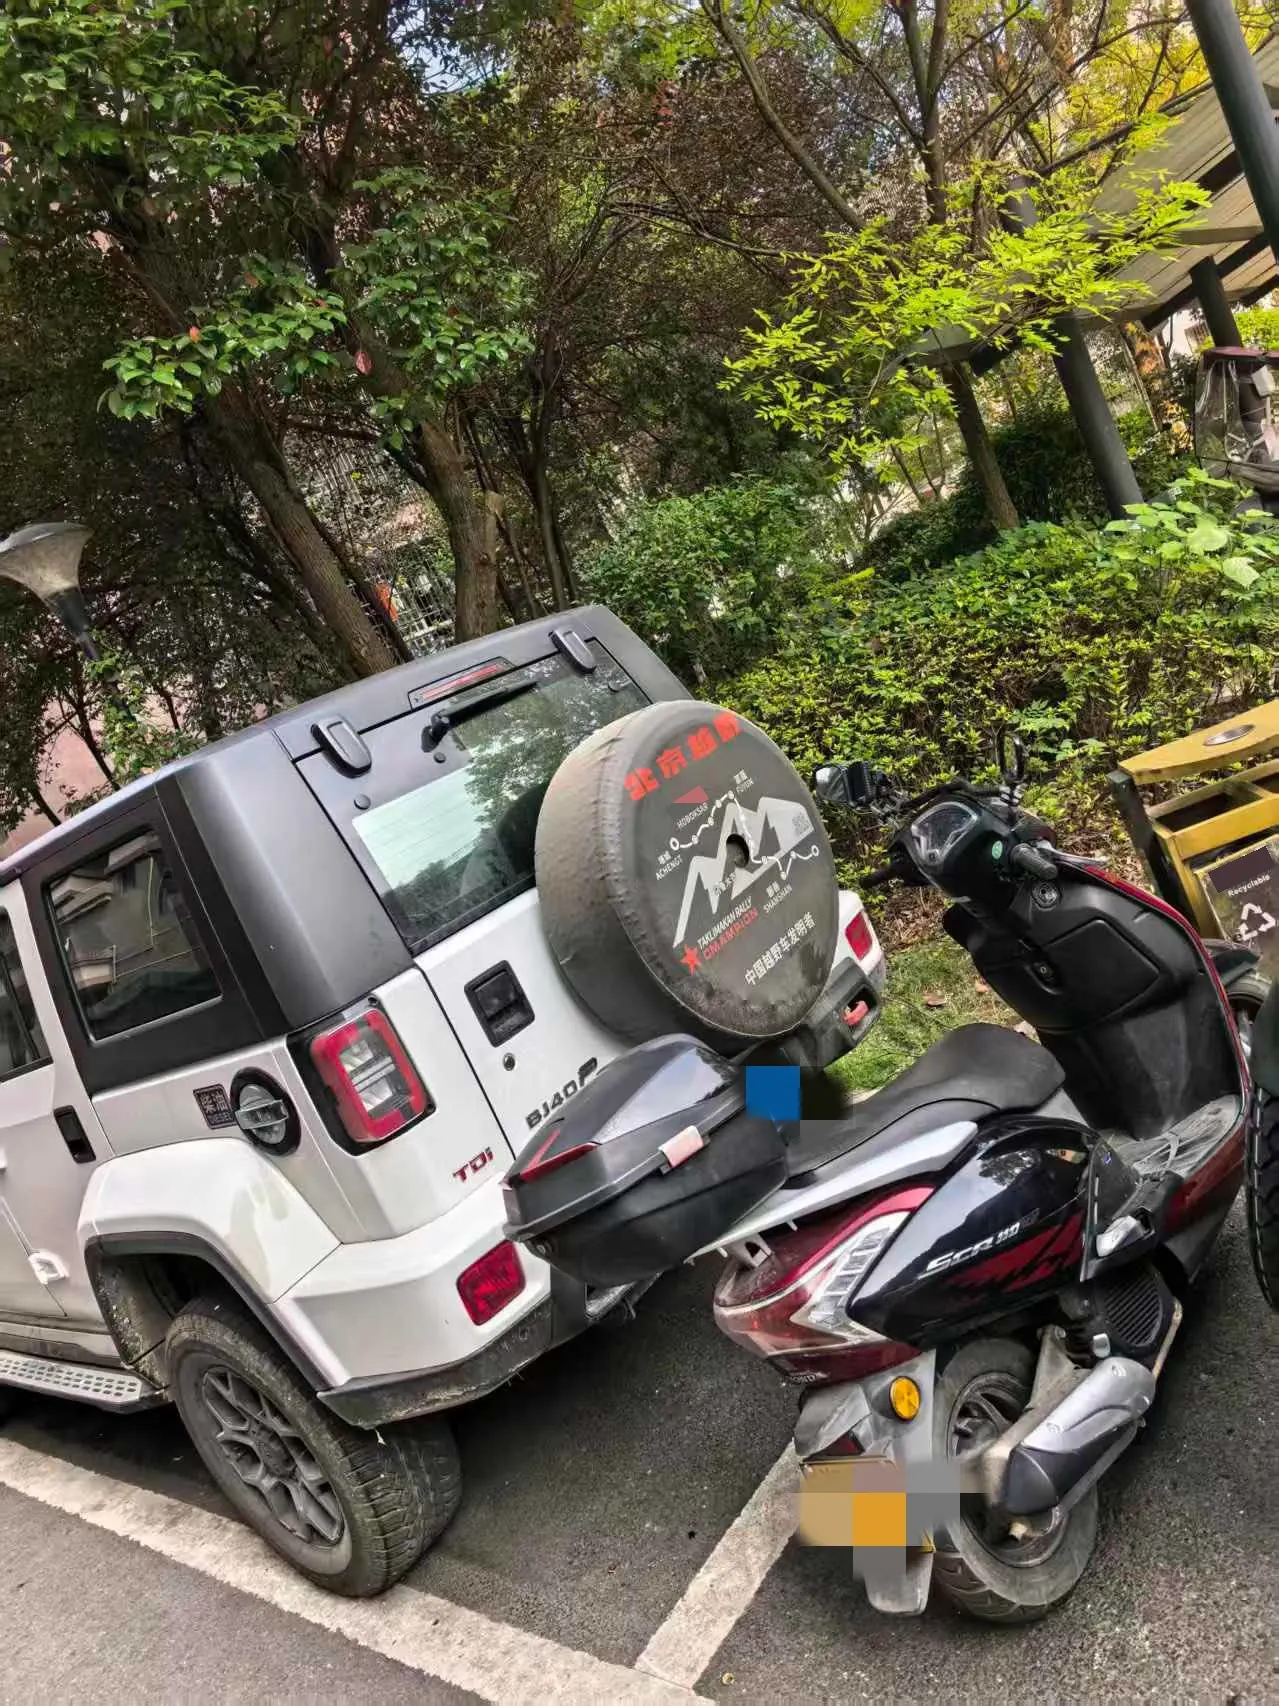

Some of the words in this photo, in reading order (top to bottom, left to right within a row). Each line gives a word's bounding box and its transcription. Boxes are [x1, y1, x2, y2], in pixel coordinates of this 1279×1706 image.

[1228, 873, 1271, 897] Recyclable
[745, 912, 815, 985] 中国越野车发明者
